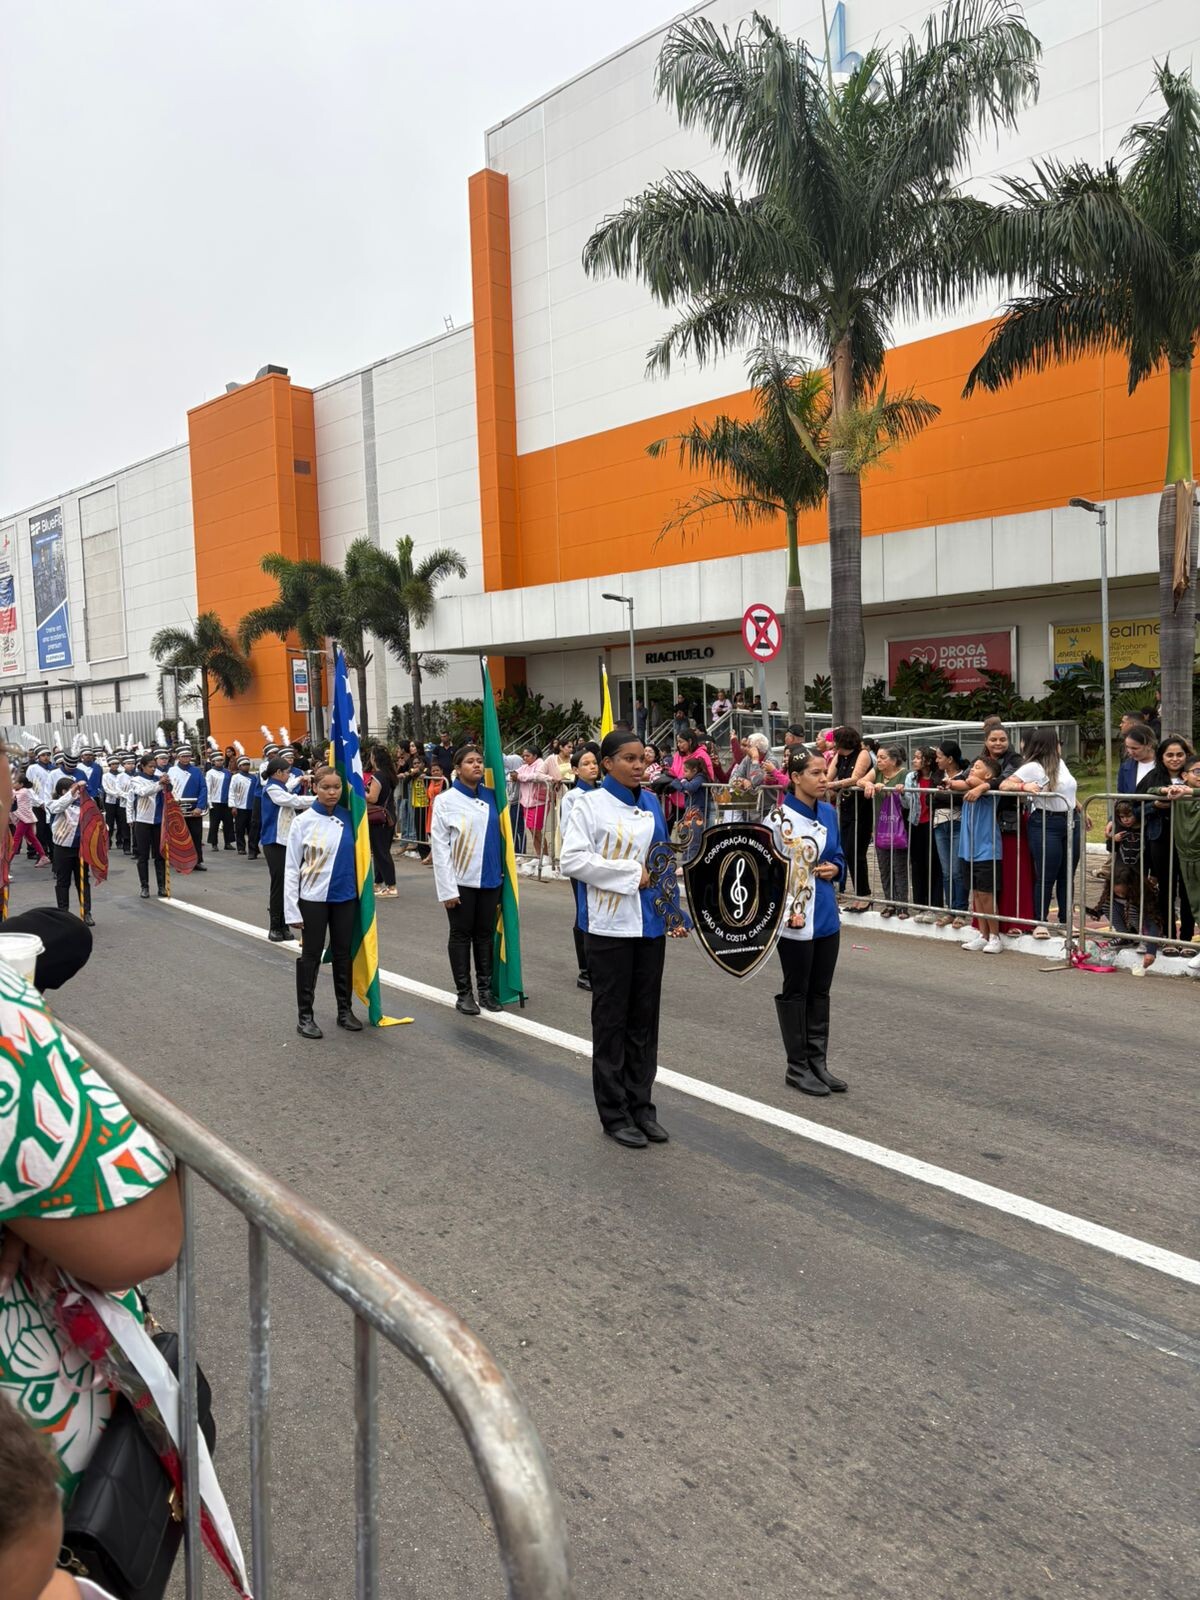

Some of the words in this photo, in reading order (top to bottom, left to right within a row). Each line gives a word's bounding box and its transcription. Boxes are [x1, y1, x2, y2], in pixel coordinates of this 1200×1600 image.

[1056, 627, 1080, 635] AGORA
[645, 646, 714, 664] RIACHUELO
[939, 643, 987, 658] DROGA
[939, 656, 988, 670] FORTES
[704, 835, 748, 864] CORPORAÇÃO
[748, 838, 774, 864] MUSICAL
[701, 909, 716, 929] JOÃO
[714, 927, 724, 939] DA
[725, 933, 748, 942] COSTA
[748, 901, 776, 938] CARVALHO
